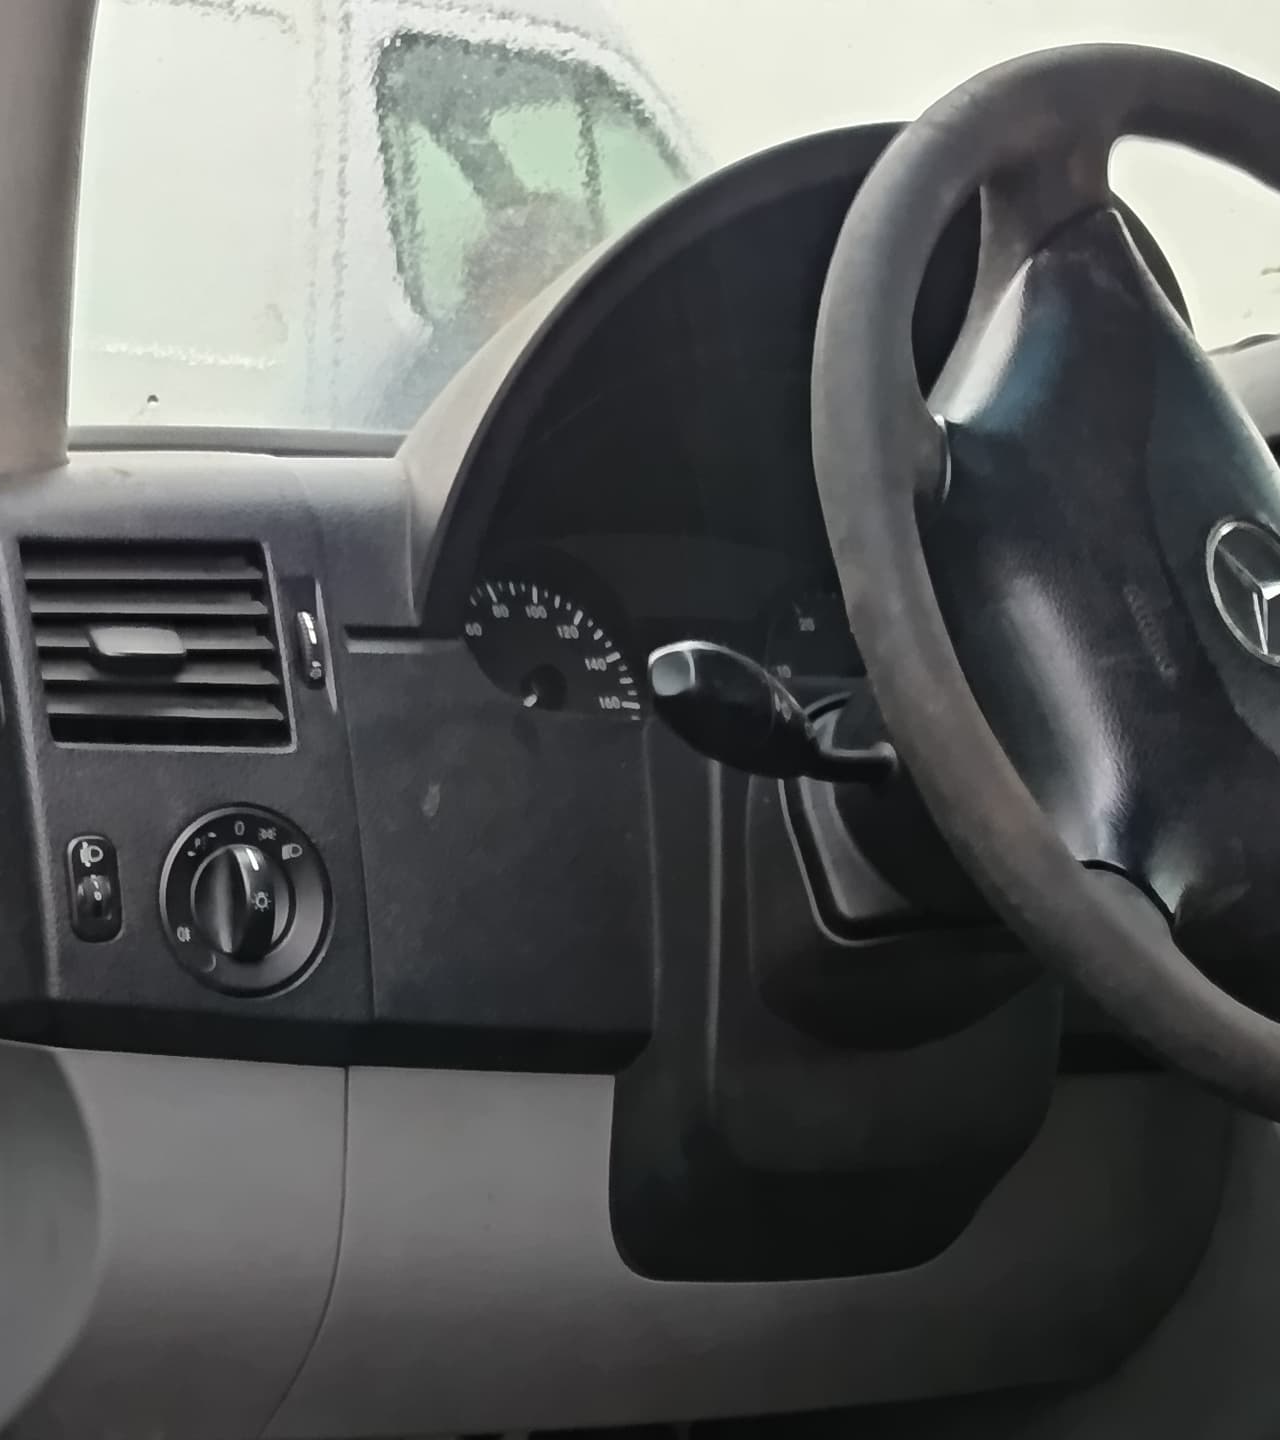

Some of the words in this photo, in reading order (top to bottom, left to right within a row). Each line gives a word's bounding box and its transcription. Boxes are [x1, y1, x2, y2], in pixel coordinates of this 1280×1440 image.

[526, 605, 547, 618] 100
[557, 625, 580, 639] 120
[584, 657, 607, 671] 140
[599, 696, 620, 709] 160
